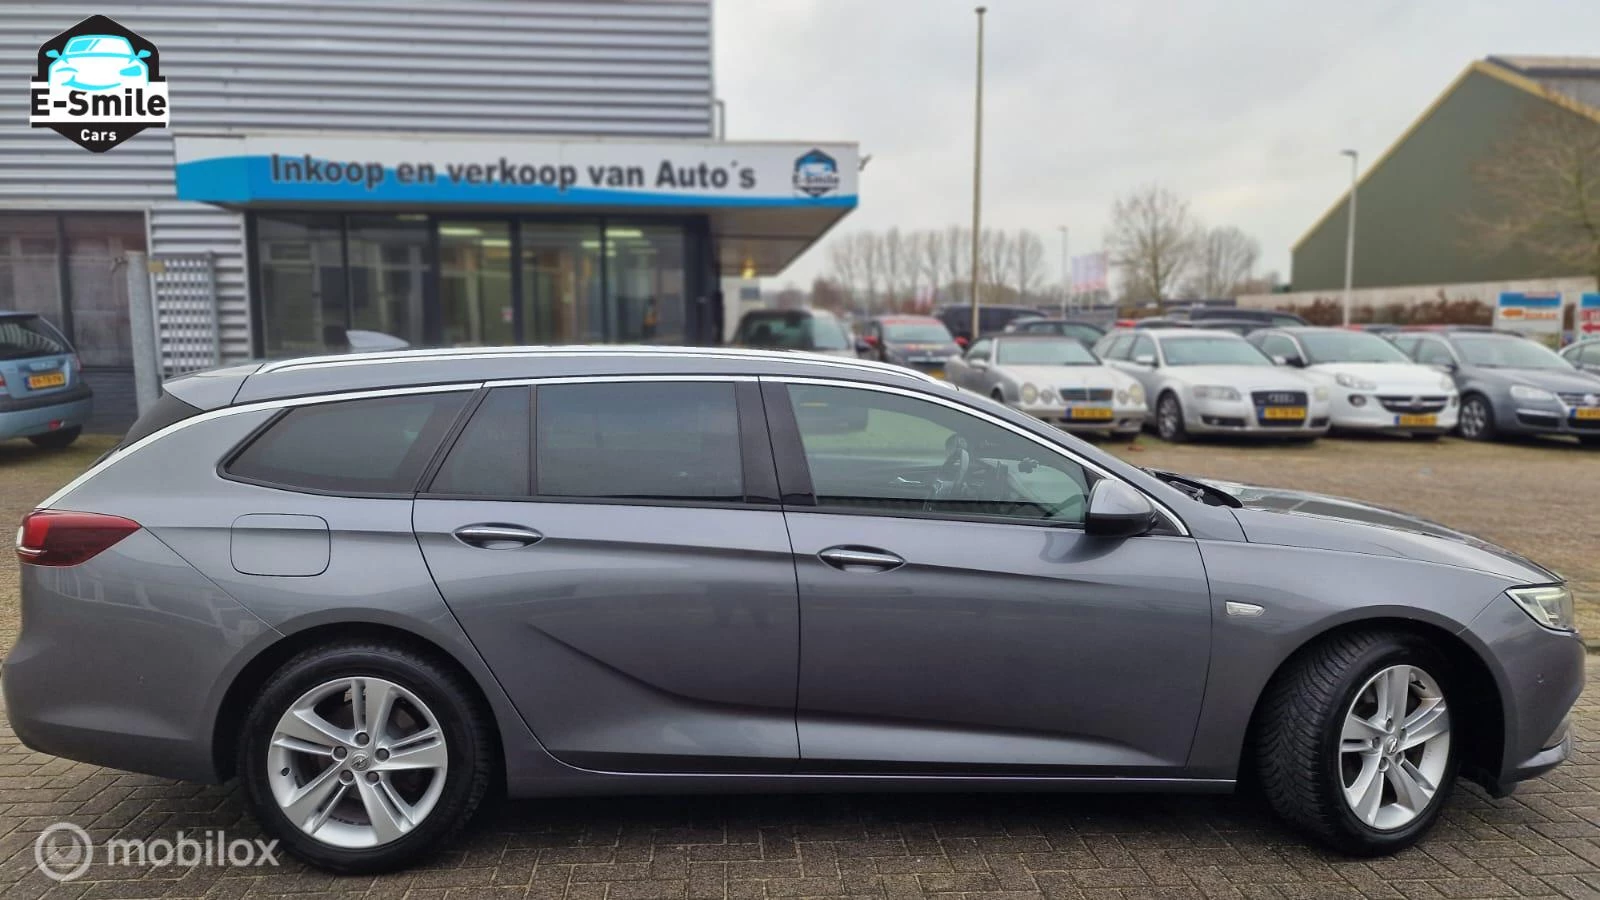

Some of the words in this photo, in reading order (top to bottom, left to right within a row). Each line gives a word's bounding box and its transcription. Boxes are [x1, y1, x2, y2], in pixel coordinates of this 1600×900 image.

[271, 153, 384, 190] Inkoop
[397, 162, 436, 183] en
[446, 157, 578, 191] verkoop
[588, 165, 645, 187] van
